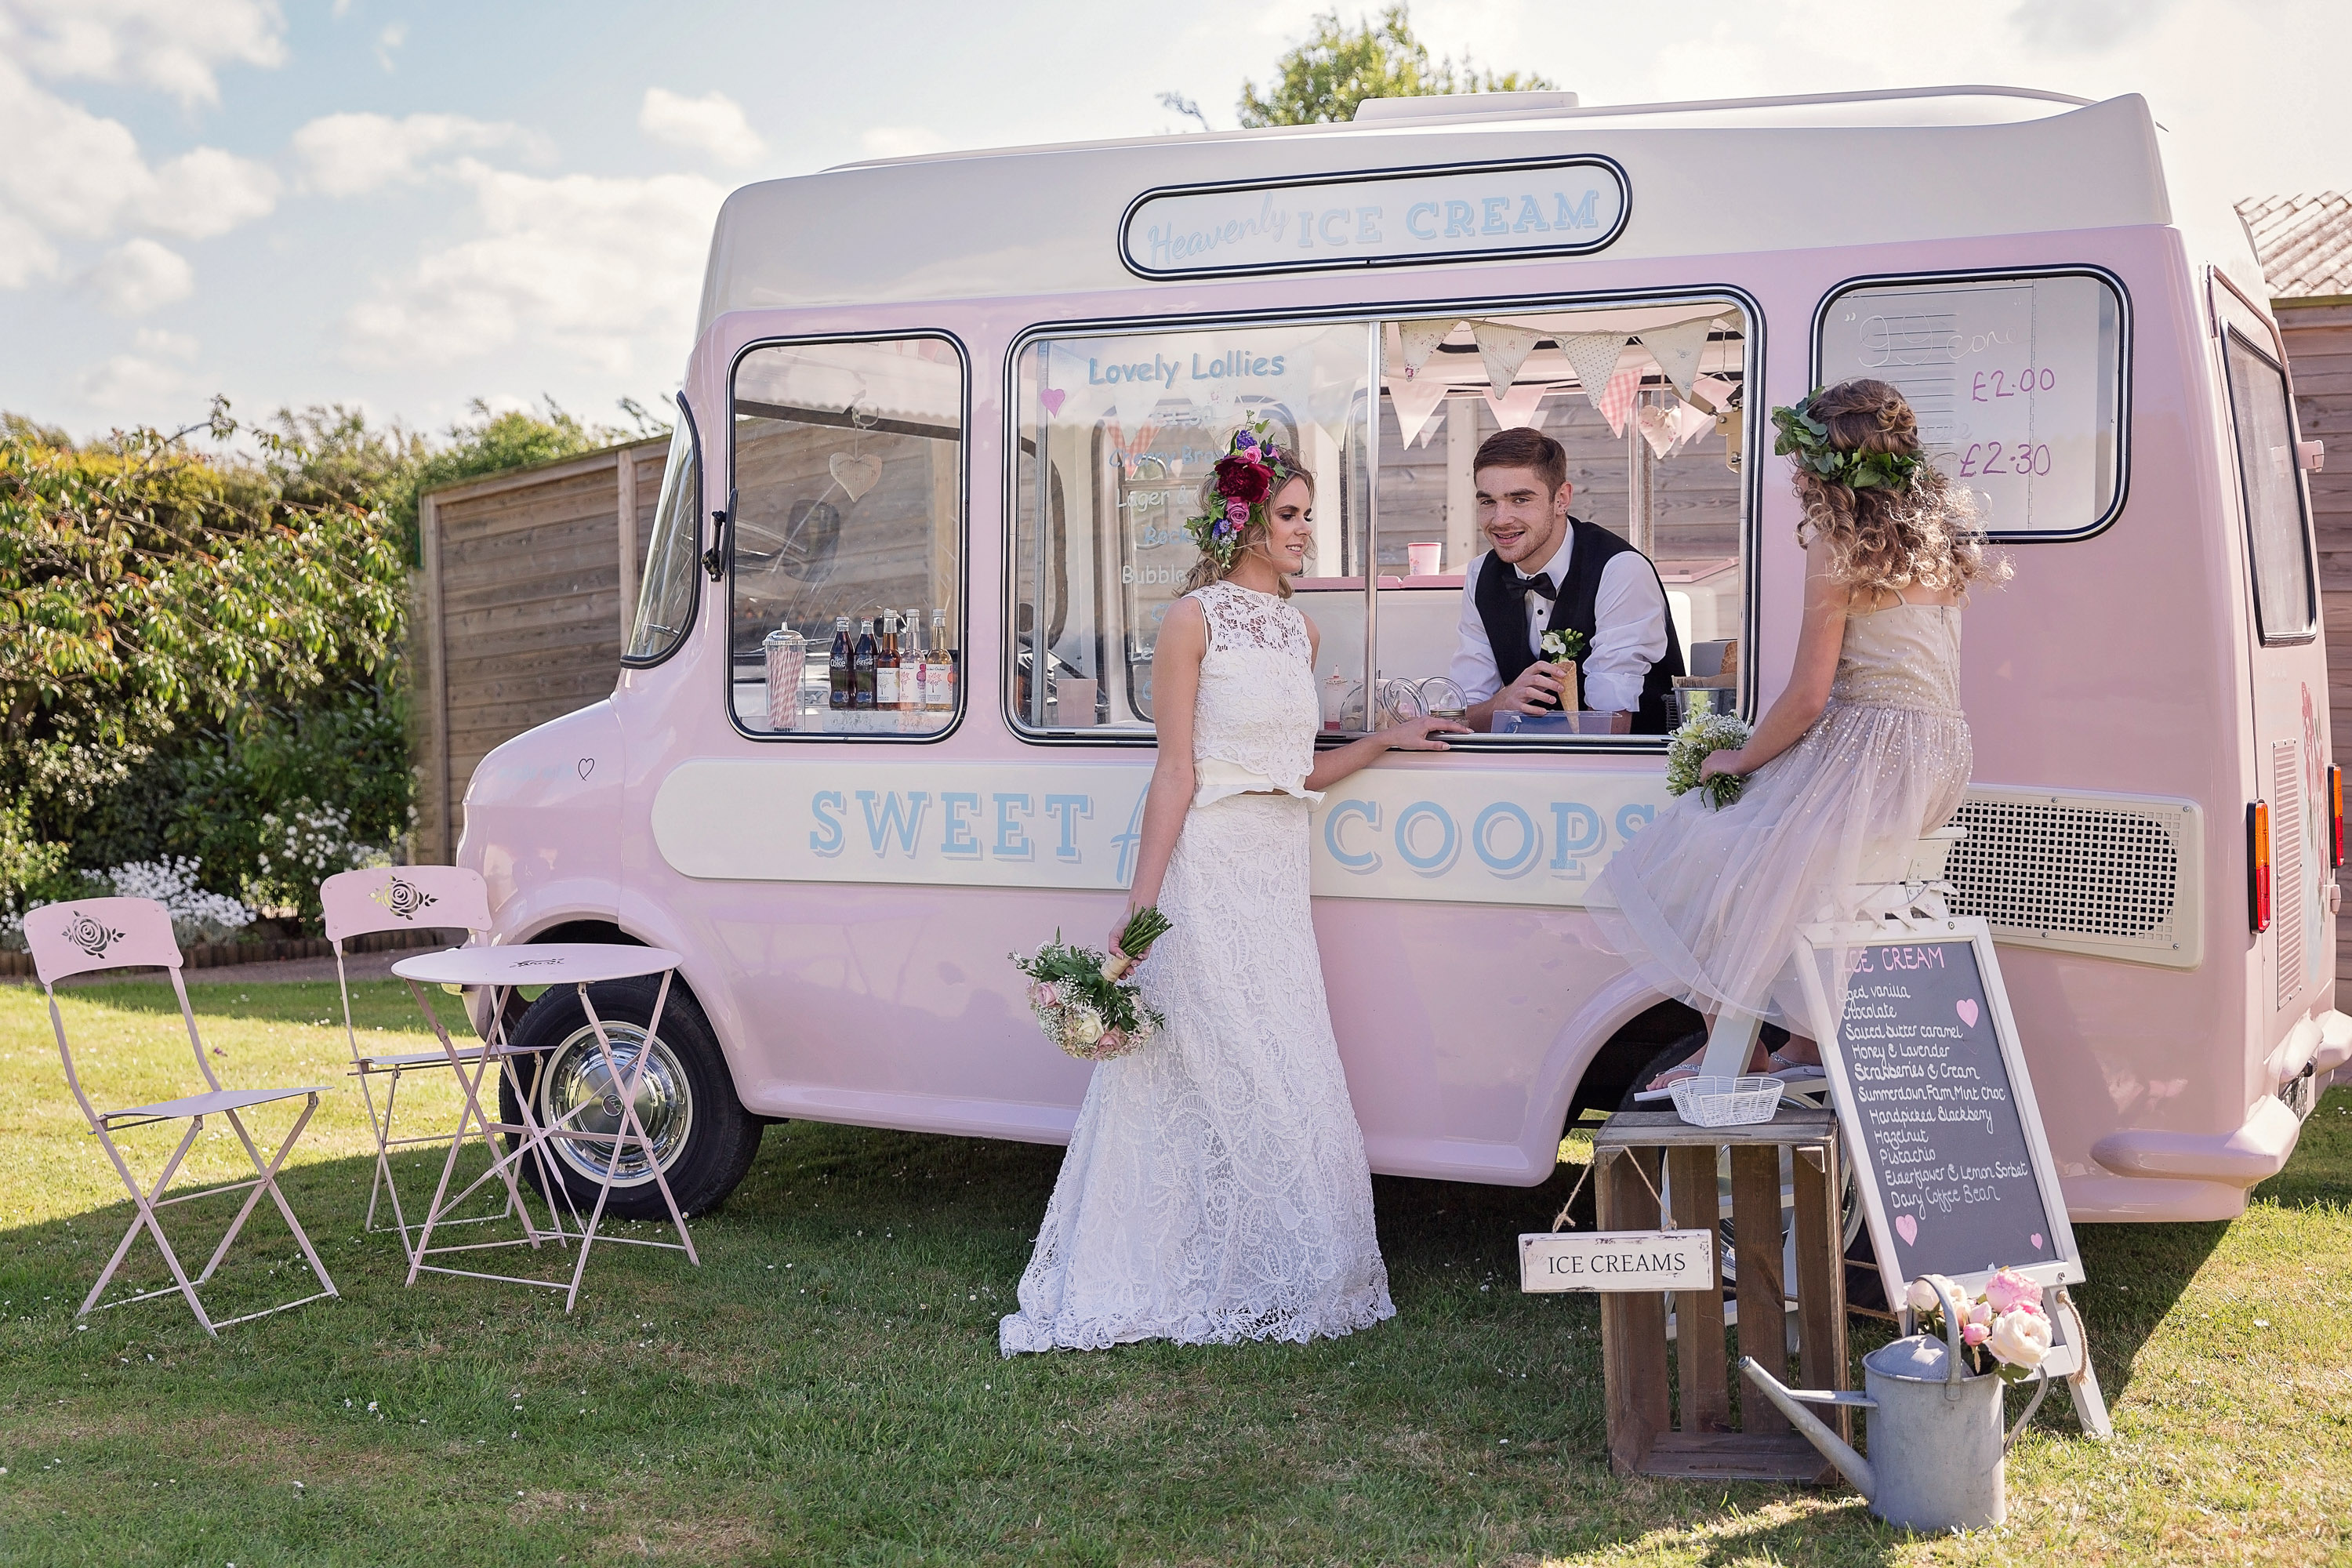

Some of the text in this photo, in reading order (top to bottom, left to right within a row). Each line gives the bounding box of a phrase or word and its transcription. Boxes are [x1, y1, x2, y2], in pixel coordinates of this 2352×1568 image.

[1148, 189, 1599, 268] Heavenly ICE CREAM
[1088, 350, 1286, 390] Lovely Lollies
[1972, 368, 2055, 402] £2.00
[1109, 448, 1177, 471] Cherry
[1960, 441, 2051, 477] £2.30
[1116, 488, 1170, 512] Lager
[1122, 563, 1187, 585] Bubble
[809, 789, 1094, 865] SWEET
[1306, 799, 1660, 881] COOPS
[1882, 946, 1945, 971] CREAM
[1871, 982, 1911, 999] vanilla
[1845, 1022, 1964, 1041] Salted butter caramel
[1851, 1043, 1951, 1068] Honey & Lavender
[1927, 1063, 1938, 1080] &
[1940, 1062, 1980, 1080] Cream
[1868, 1105, 1994, 1134] Handpicked Blackberry
[1873, 1128, 1929, 1150] Hazelnut
[1879, 1145, 1936, 1166] Pistachio
[1885, 1160, 2028, 1189] Elderflower & Lemon Sorbet
[1925, 1185, 1961, 1213] Coffee
[1962, 1183, 2001, 1203] Bean
[1548, 1253, 1686, 1275] ICE CREAMS
